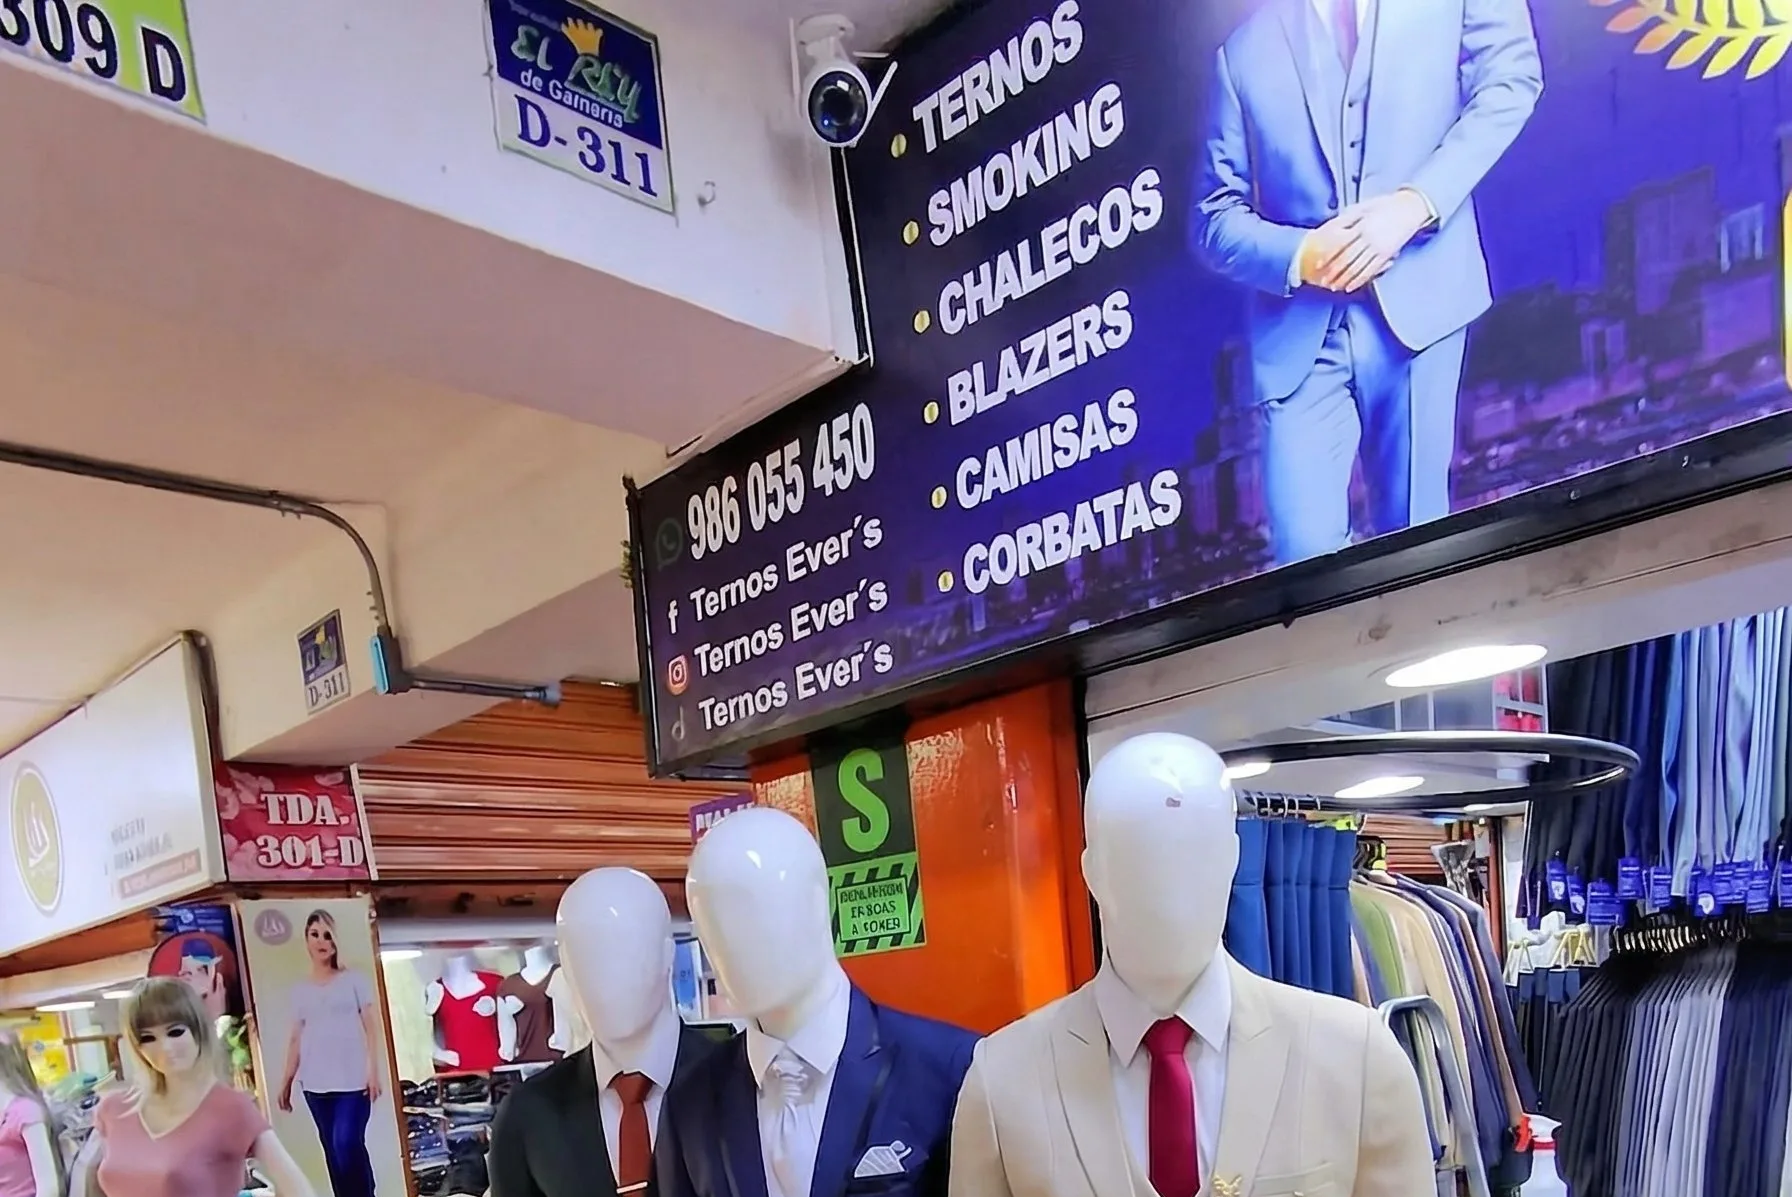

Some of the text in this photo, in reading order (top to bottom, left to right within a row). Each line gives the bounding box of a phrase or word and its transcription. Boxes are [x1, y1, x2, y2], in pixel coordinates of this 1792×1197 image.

[140, 26, 186, 102] D
[520, 69, 543, 92] de
[912, 0, 1084, 154] TERNOS
[514, 93, 658, 197] D-311
[927, 82, 1125, 247] SMOKING
[938, 168, 1164, 335] CHALECOS
[947, 289, 1134, 426] BLAZERS
[687, 402, 876, 560] 986 055 450
[956, 388, 1139, 510] CAMISAS
[963, 469, 1183, 594] CORBATAS
[690, 563, 778, 622] Ternos
[308, 671, 346, 707] D-311
[694, 621, 784, 678] Ternos
[698, 680, 788, 731] Ternos
[256, 834, 366, 868] 301-D
[260, 792, 350, 826] TDA.
[837, 747, 890, 853] S
